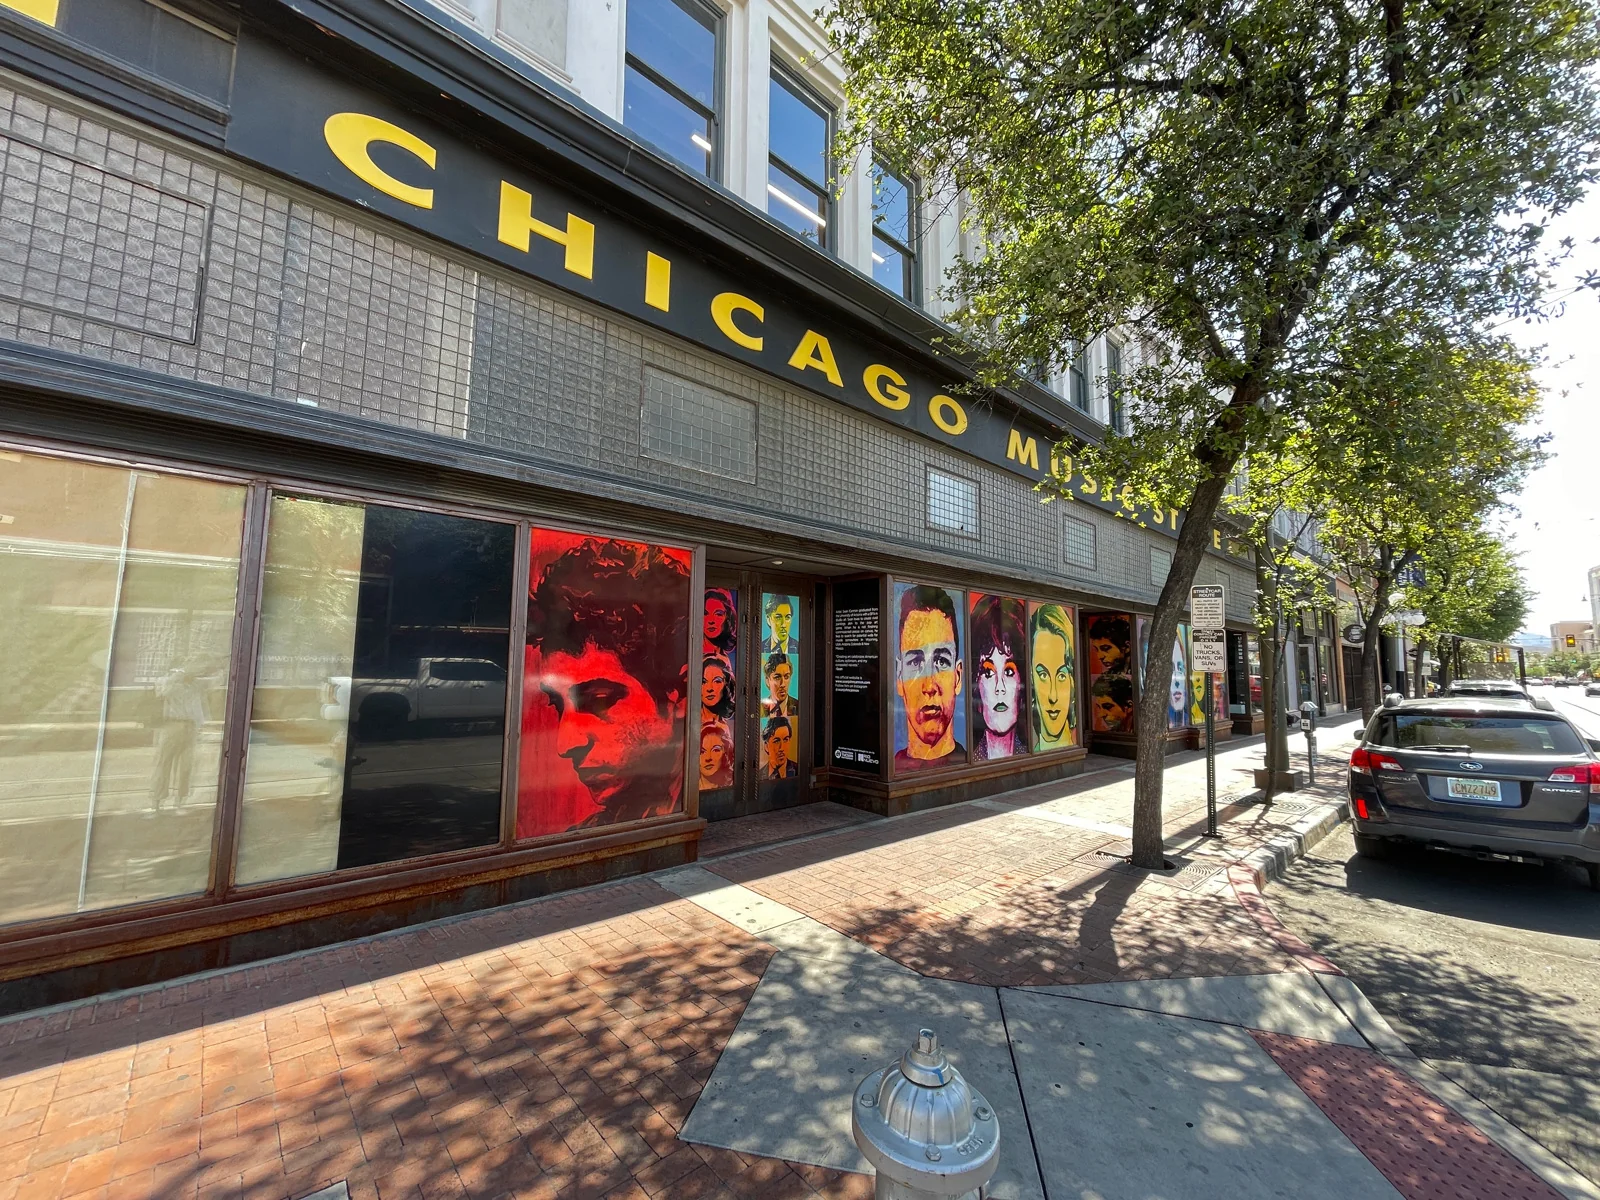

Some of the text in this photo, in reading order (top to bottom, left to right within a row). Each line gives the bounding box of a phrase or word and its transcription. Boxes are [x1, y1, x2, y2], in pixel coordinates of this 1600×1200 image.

[323, 112, 1221, 550] CHICAGO MUSC STE
